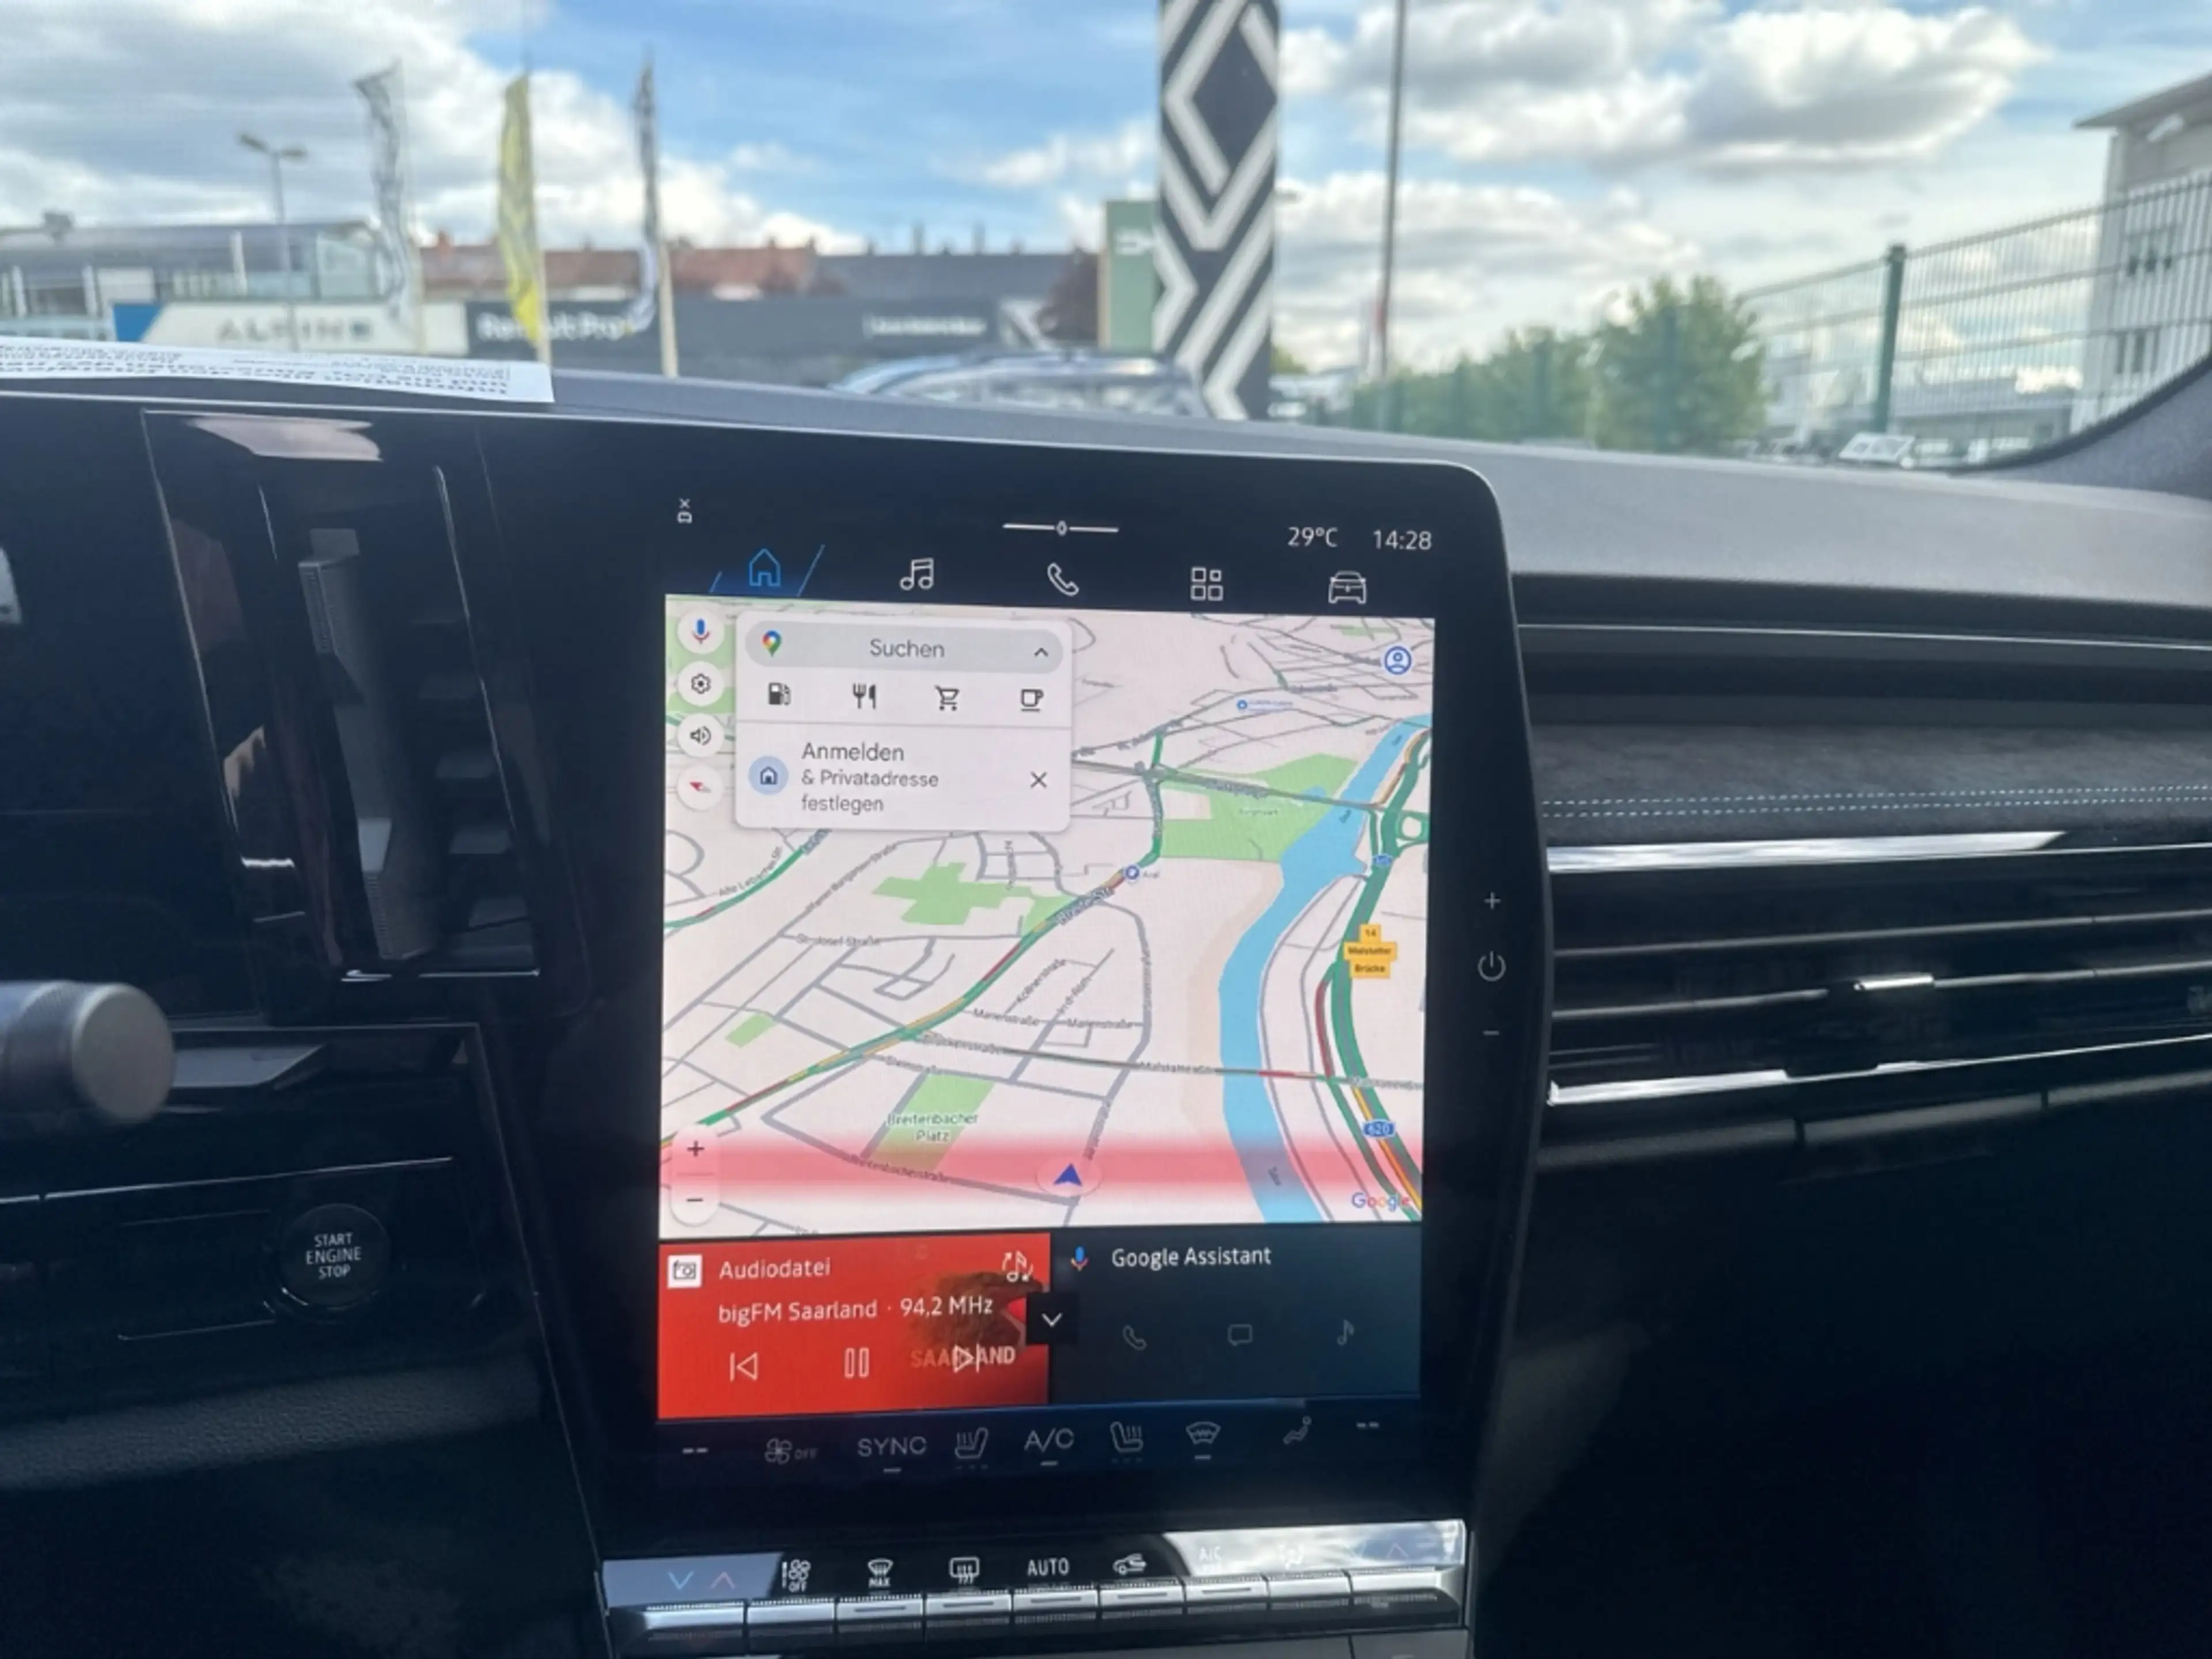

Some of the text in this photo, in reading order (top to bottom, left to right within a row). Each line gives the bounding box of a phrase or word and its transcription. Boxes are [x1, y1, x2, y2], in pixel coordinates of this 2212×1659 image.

[1287, 527, 1338, 548] 29°C
[1373, 530, 1433, 550] 14:28
[869, 638, 945, 658] Suchen
[801, 742, 904, 762] Anmelden
[801, 768, 940, 787] & Privatadresse
[801, 795, 884, 814] festlegen
[915, 1130, 950, 1143] Platz
[315, 1232, 352, 1247] START
[305, 1246, 362, 1265] ENGINE
[1111, 1247, 1272, 1271] Google Assistant
[318, 1264, 351, 1279] STOP
[719, 1257, 831, 1280] Audiodatei
[718, 1304, 782, 1327] bigFM
[789, 1300, 878, 1321] Saarland
[949, 1296, 994, 1315] MHz
[857, 1436, 927, 1457] SYNC
[1024, 1429, 1074, 1452] A/C
[1027, 1556, 1070, 1577] AUTO
[869, 1577, 891, 1588] MAX
